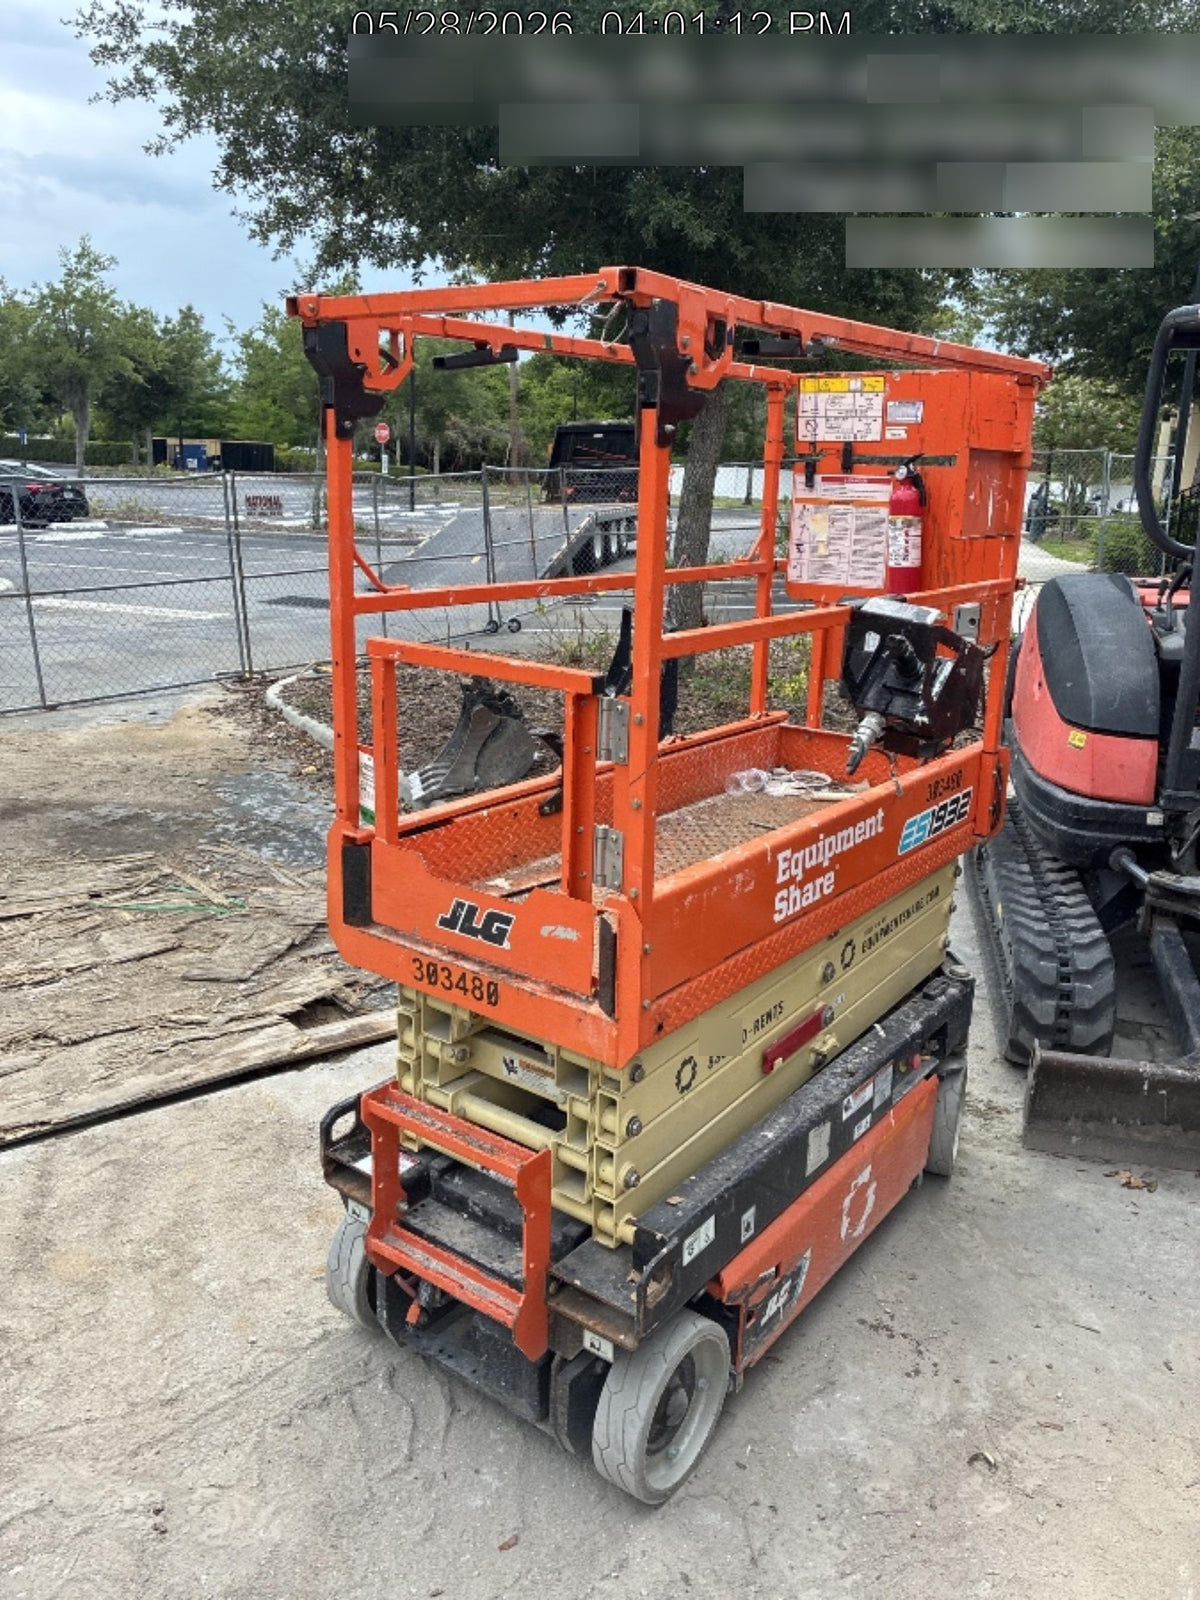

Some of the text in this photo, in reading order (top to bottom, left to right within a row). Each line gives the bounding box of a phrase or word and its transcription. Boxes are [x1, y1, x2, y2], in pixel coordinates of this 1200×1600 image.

[776, 807, 885, 884] Equipment
[898, 786, 973, 855] ES1932
[773, 870, 835, 923] Share
[436, 898, 515, 949] JLG
[412, 958, 499, 1007] 303480
